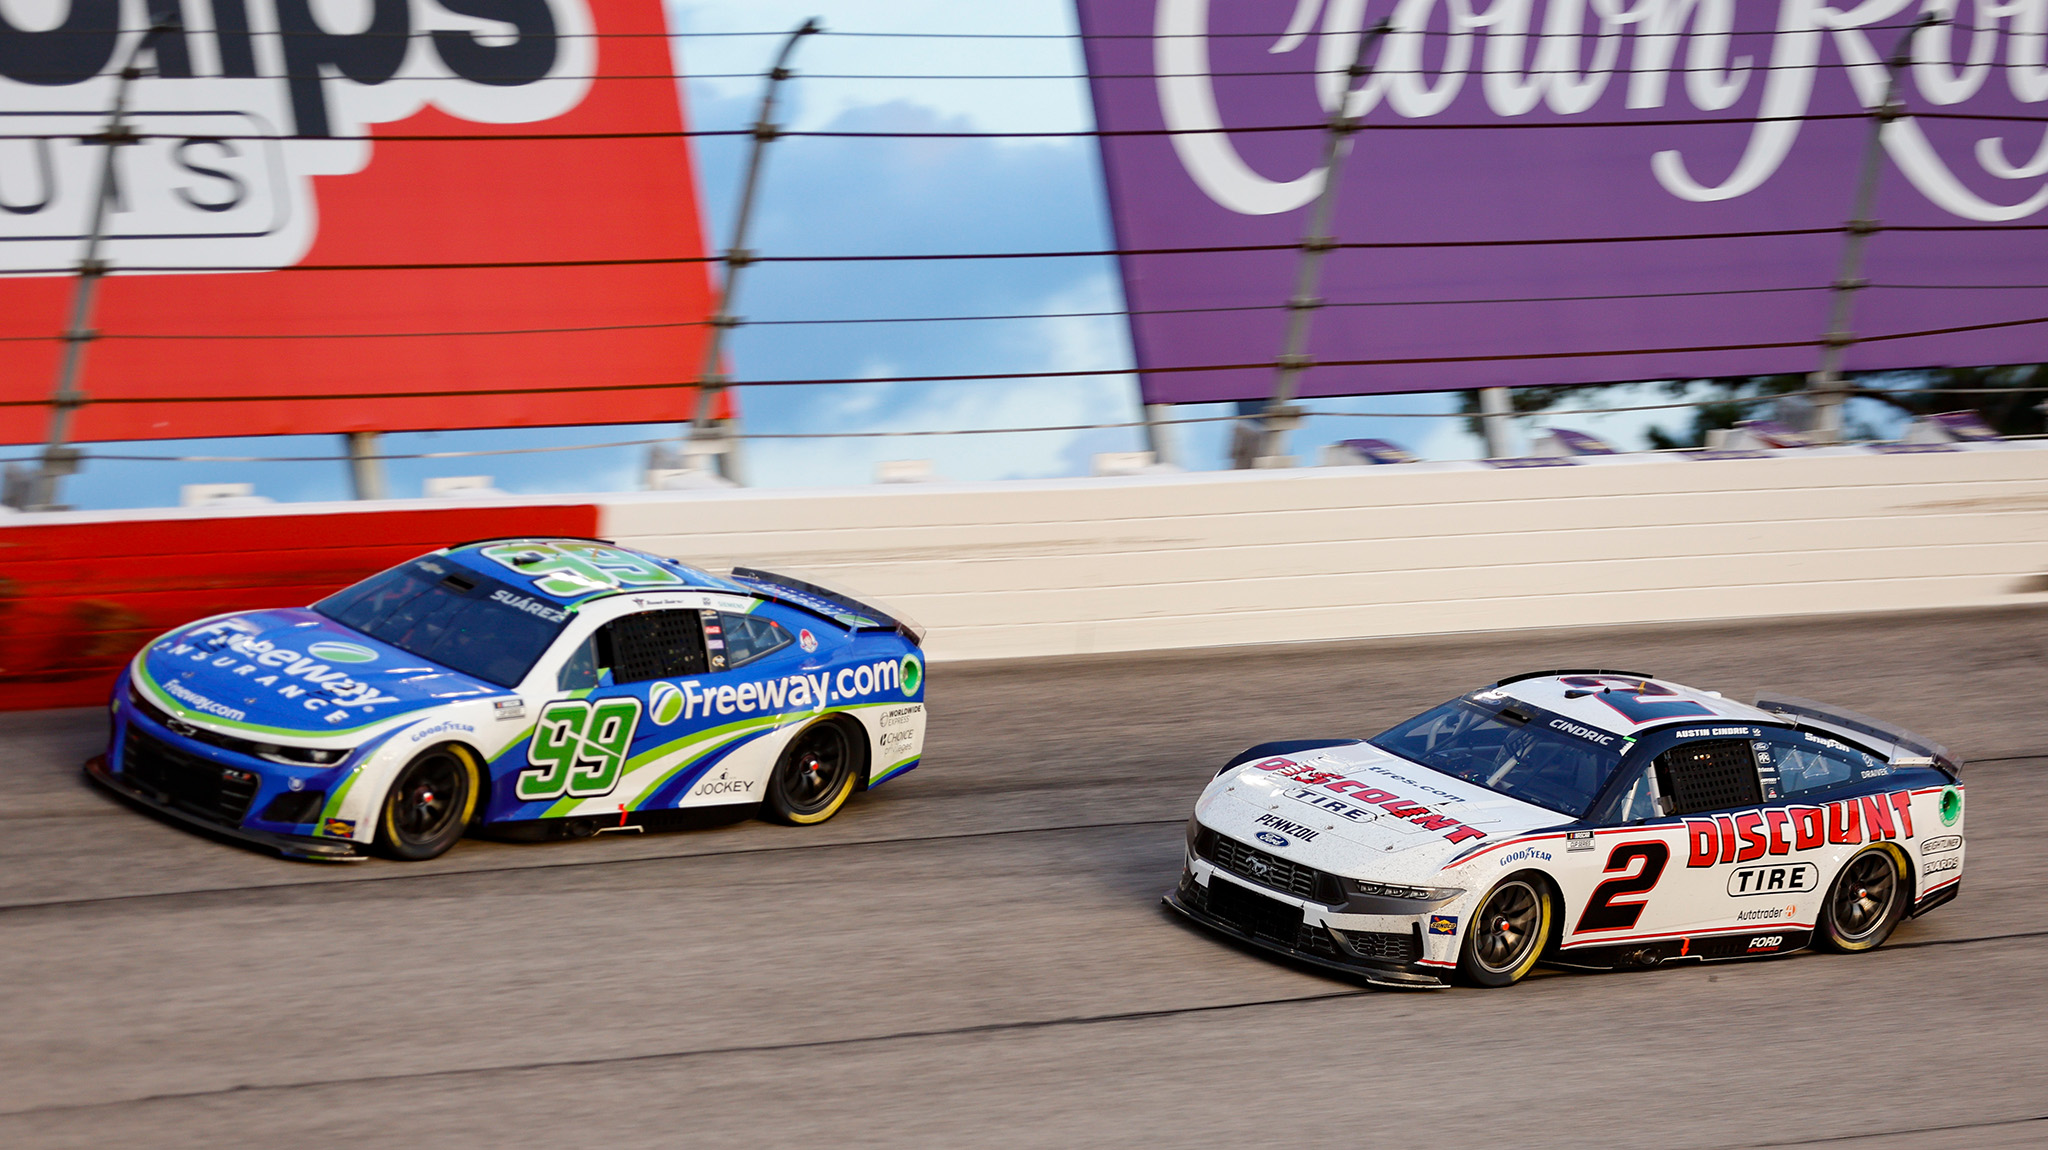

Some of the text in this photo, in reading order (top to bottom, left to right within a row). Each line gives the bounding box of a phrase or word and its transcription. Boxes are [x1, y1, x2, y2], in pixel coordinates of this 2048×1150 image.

[480, 542, 685, 597] 99
[489, 590, 567, 624] SUÁREZ
[188, 621, 400, 707] Freeway
[152, 641, 350, 724] INSURANCE
[683, 659, 899, 719] Freeway.com
[162, 679, 246, 721] Freeway.com
[888, 705, 922, 718] WORLDWIDE
[1560, 676, 1719, 726] 2
[886, 729, 914, 744] CHOICE
[888, 715, 911, 727] EXPRESS
[1549, 719, 1615, 746] CINDRIC
[1676, 727, 1750, 739] AUSTIN CINDRIC
[515, 697, 643, 801] 99
[695, 780, 754, 796] JOCKEY
[1255, 757, 1487, 845] DISCOUNT
[1369, 765, 1467, 803] tires.com
[1299, 789, 1368, 820] TIRE
[1255, 813, 1320, 843] PENNZOIL
[1686, 790, 1914, 869] DISCOUNT
[1572, 839, 1671, 935] 2
[1738, 867, 1806, 892] TIRE
[1736, 907, 1784, 921] Autotrader
[1748, 936, 1783, 949] FORD
